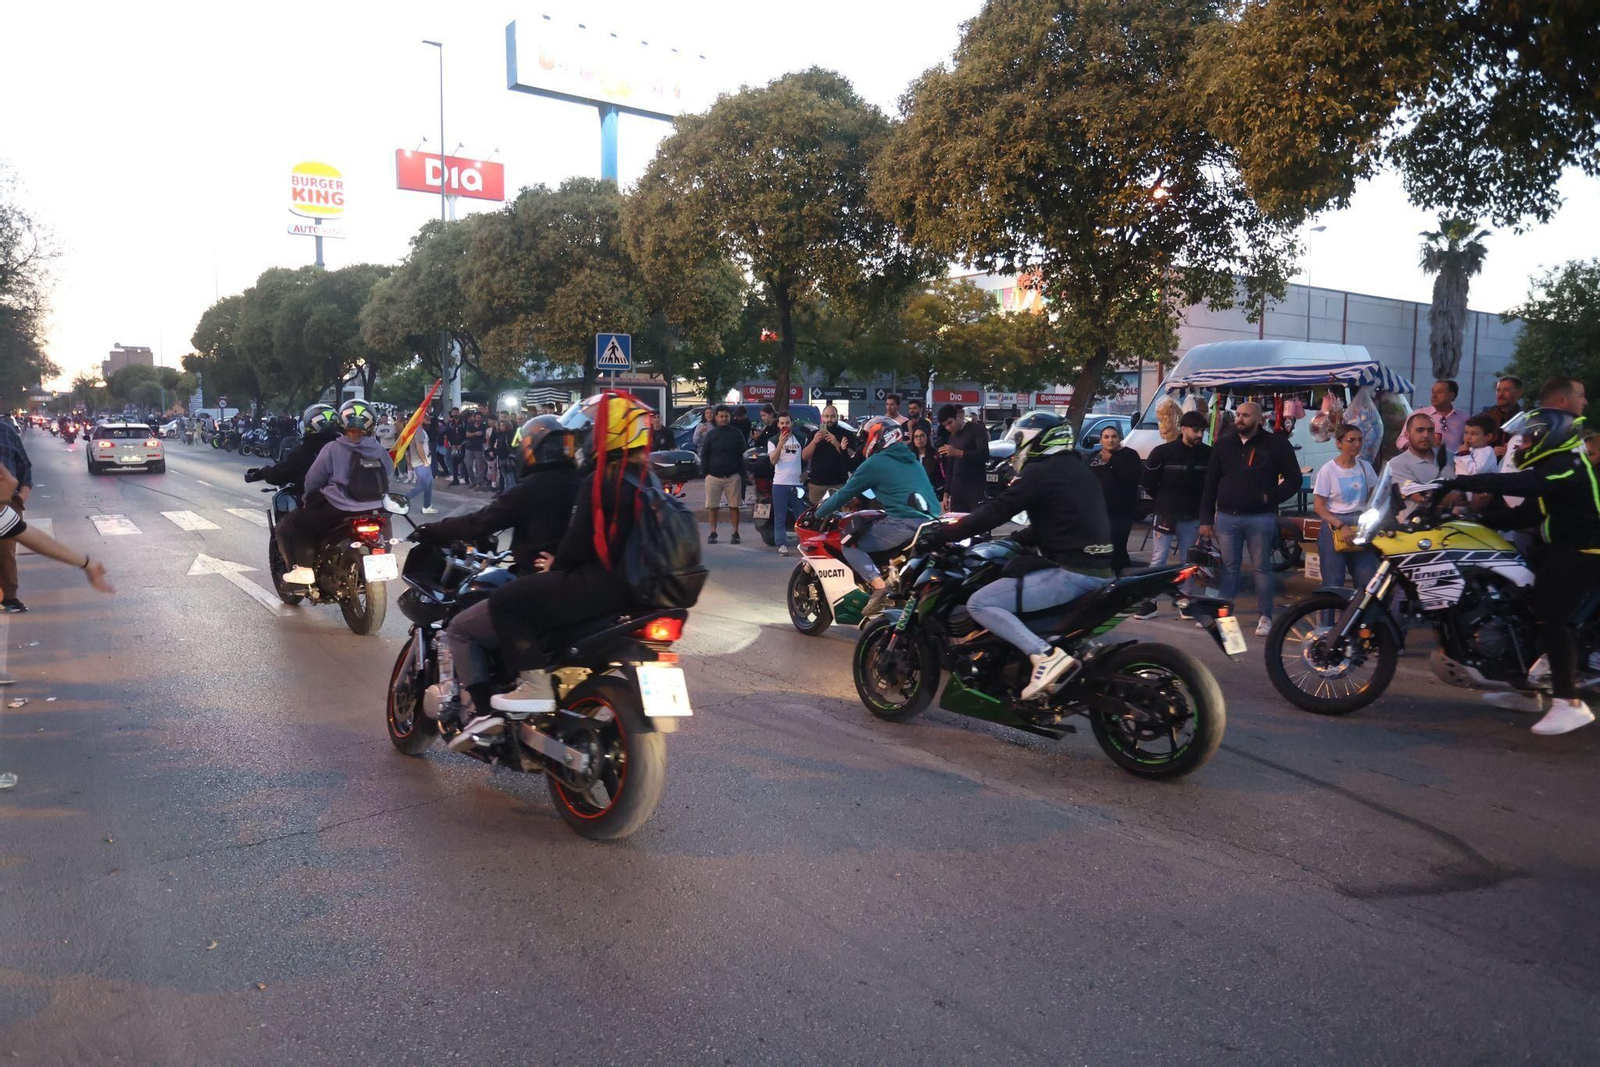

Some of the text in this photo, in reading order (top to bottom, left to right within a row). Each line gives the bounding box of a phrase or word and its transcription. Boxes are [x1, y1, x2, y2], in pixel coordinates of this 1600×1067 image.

[291, 175, 344, 190] BURGER
[292, 187, 345, 206] KING
[293, 225, 320, 234] AUTO
[818, 568, 845, 578] DUCATI
